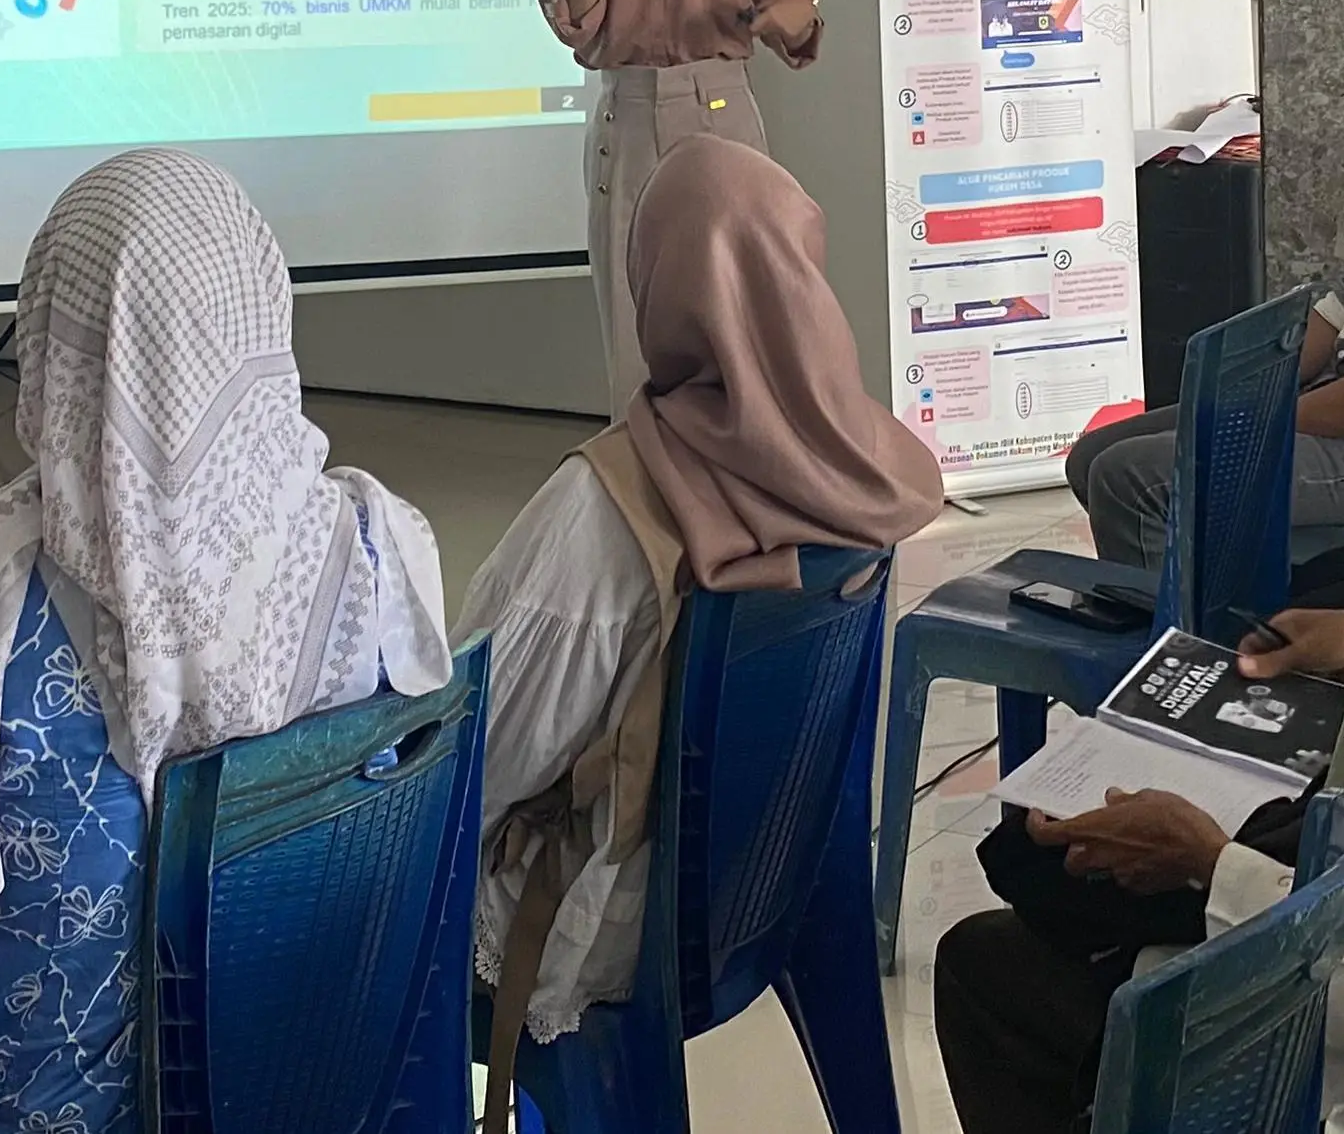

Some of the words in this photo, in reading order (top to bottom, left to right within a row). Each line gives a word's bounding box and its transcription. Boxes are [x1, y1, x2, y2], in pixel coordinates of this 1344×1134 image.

[162, 4, 199, 18] Tren
[208, 2, 253, 17] 2025:
[261, 0, 296, 15] 70%
[306, 0, 350, 14] bisnis
[162, 23, 251, 43] pemasaran
[256, 21, 301, 41] digital
[562, 95, 574, 108] 2
[1160, 665, 1210, 709] DIGITAL
[1168, 661, 1229, 720] MARKETING
